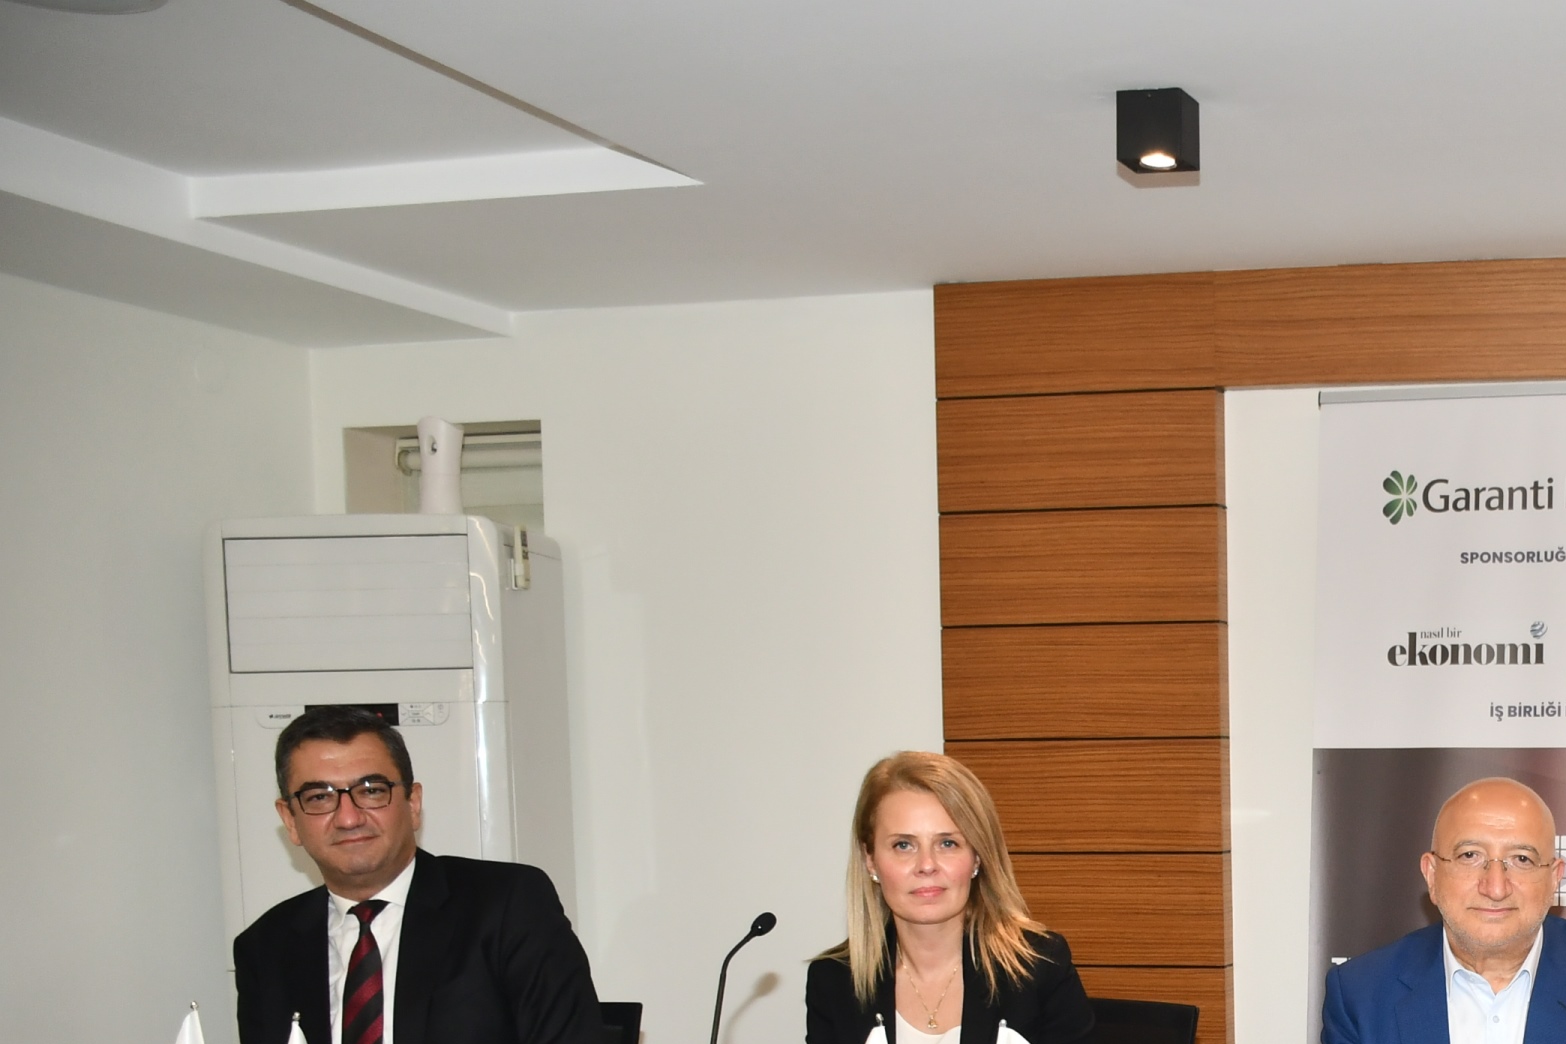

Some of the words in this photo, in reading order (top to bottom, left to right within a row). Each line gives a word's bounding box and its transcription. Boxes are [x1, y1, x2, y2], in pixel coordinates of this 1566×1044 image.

[1422, 477, 1554, 513] Garanti
[1420, 627, 1444, 640] nasıl
[1446, 626, 1462, 639] bir
[1387, 631, 1545, 667] ekonomi
[1490, 704, 1504, 722] İŞ
[1507, 702, 1562, 719] BİRLİĞİ
